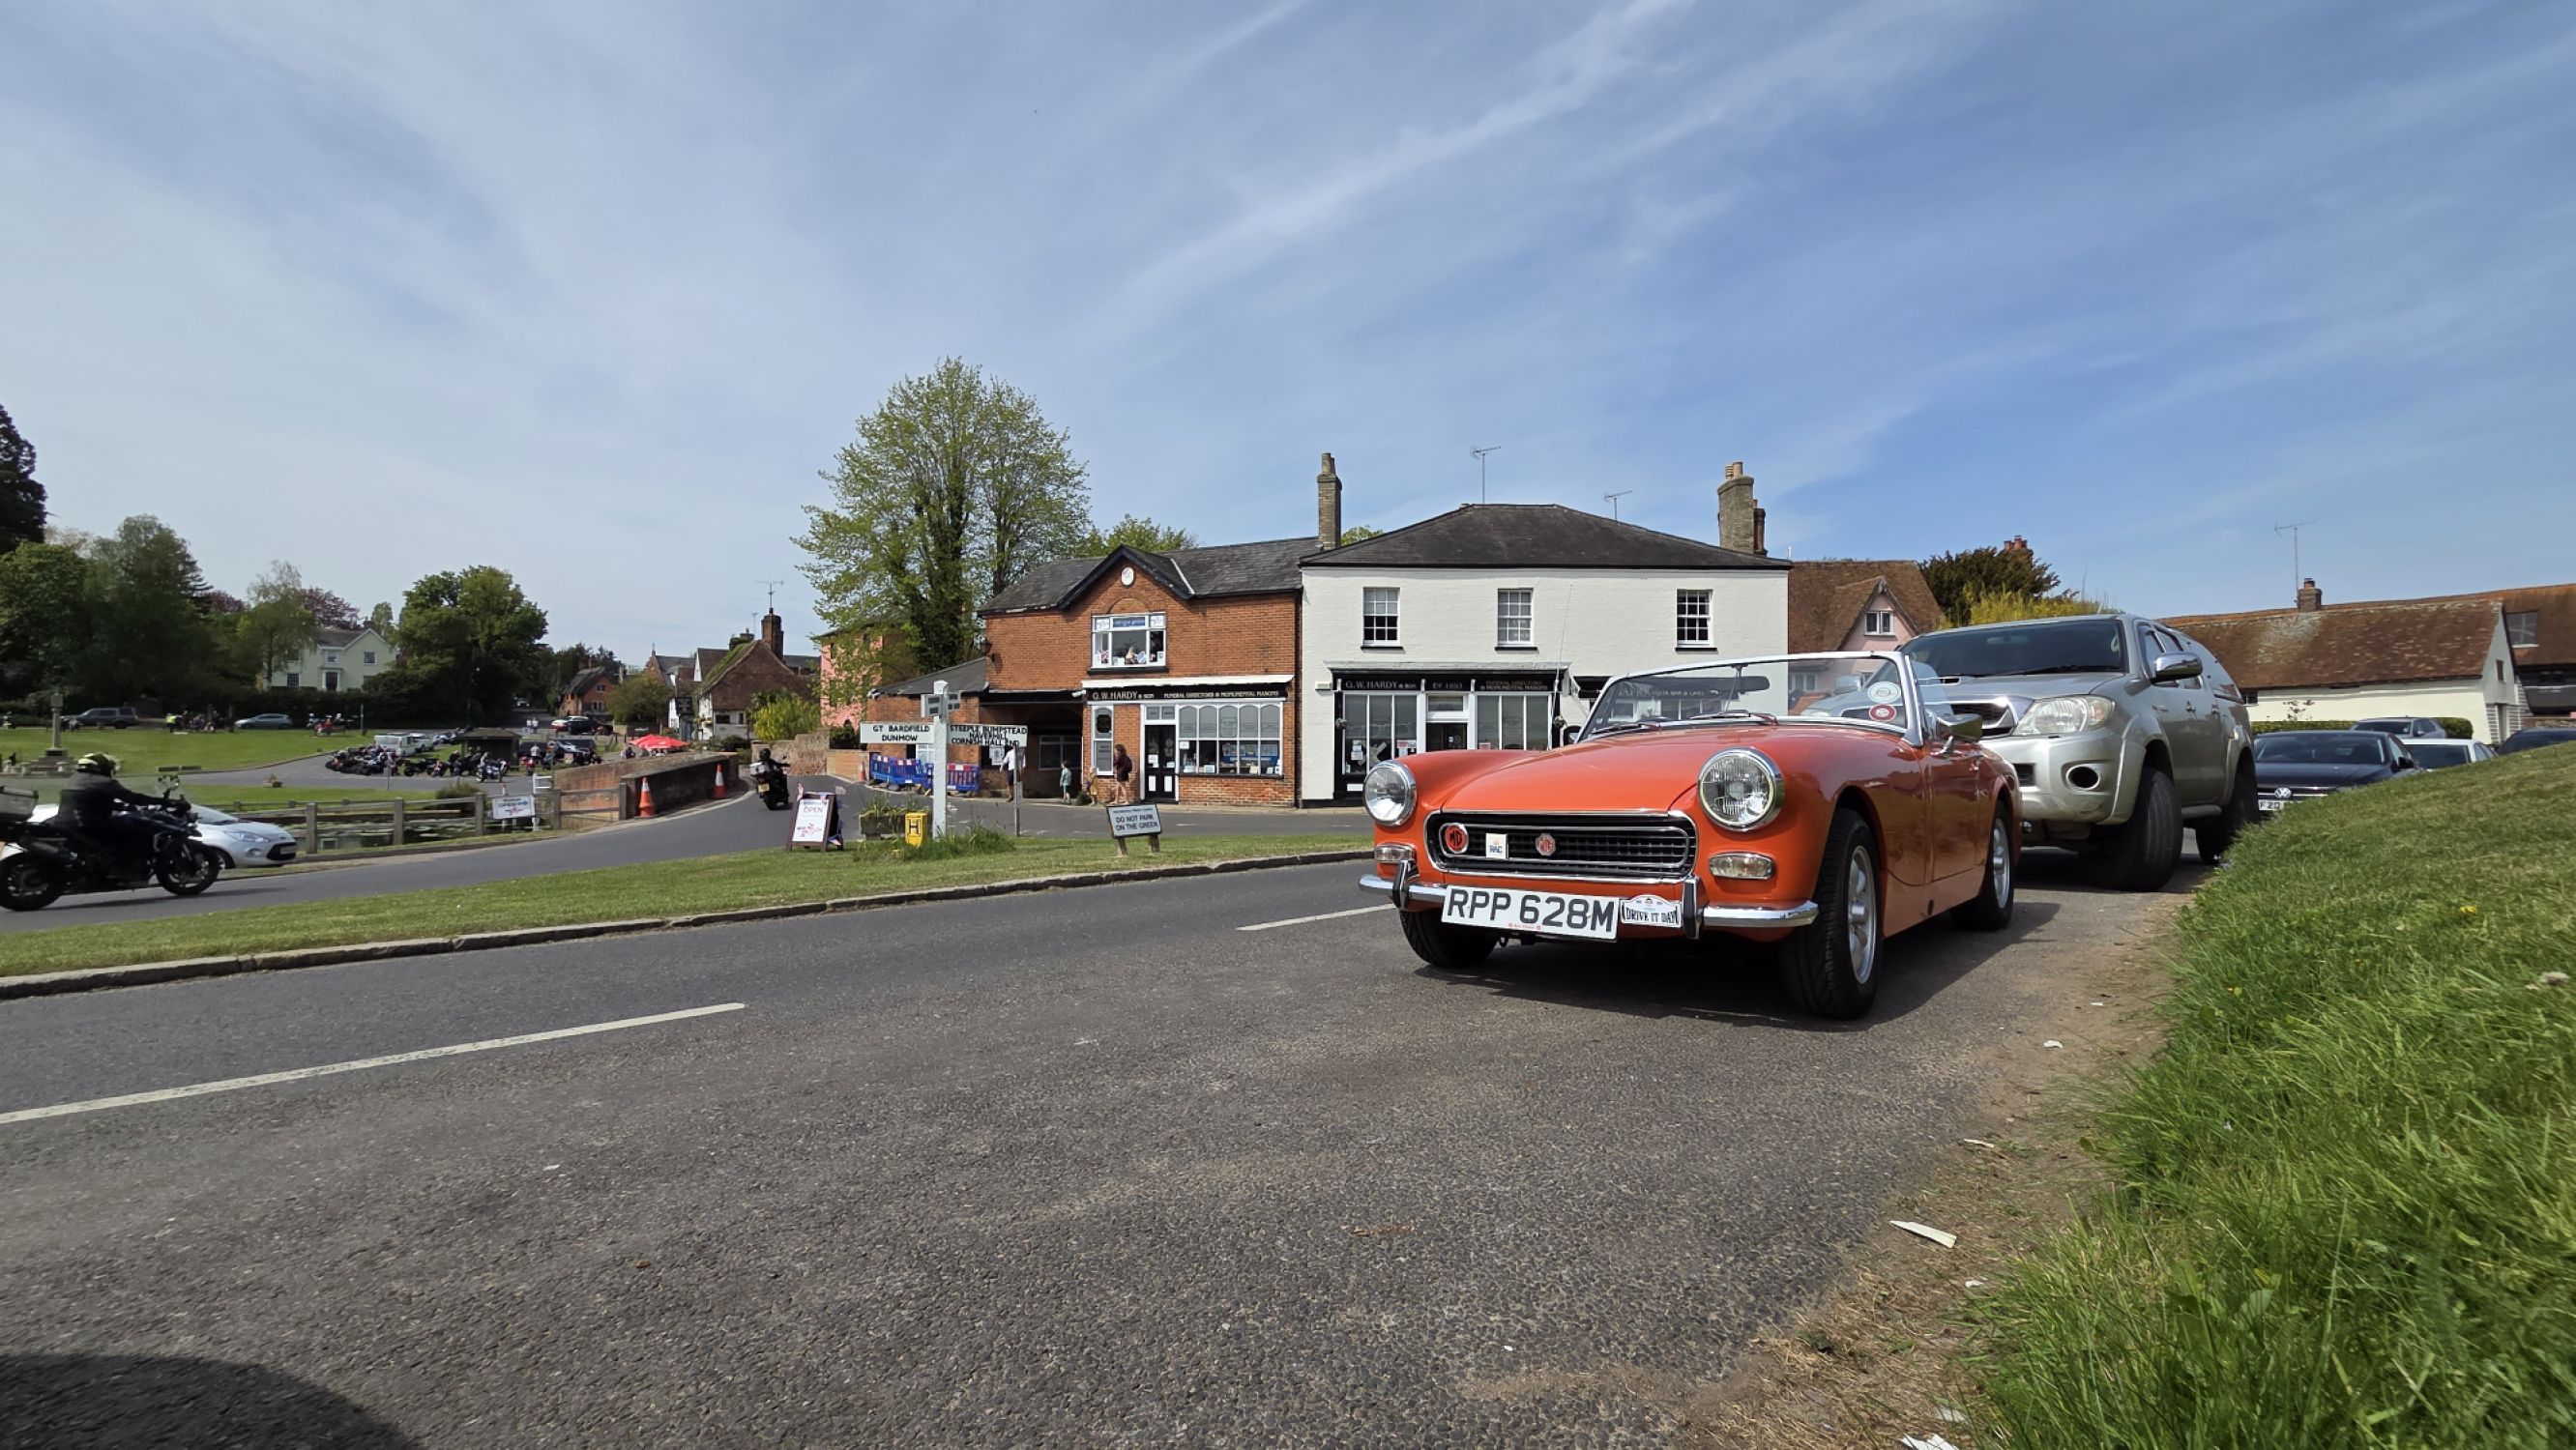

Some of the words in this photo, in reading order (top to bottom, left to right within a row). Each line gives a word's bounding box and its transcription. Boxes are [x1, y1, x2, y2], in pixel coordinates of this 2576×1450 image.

[872, 724, 884, 733] GT
[888, 724, 930, 733] BARDFIELD
[984, 738, 1004, 746] HALL
[909, 818, 920, 835] H
[1489, 845, 1503, 854] RAC
[1448, 888, 1511, 921] RPP
[1519, 894, 1615, 933] 628M
[1625, 907, 1650, 921] DRIVE
[1651, 913, 1659, 922] IT
